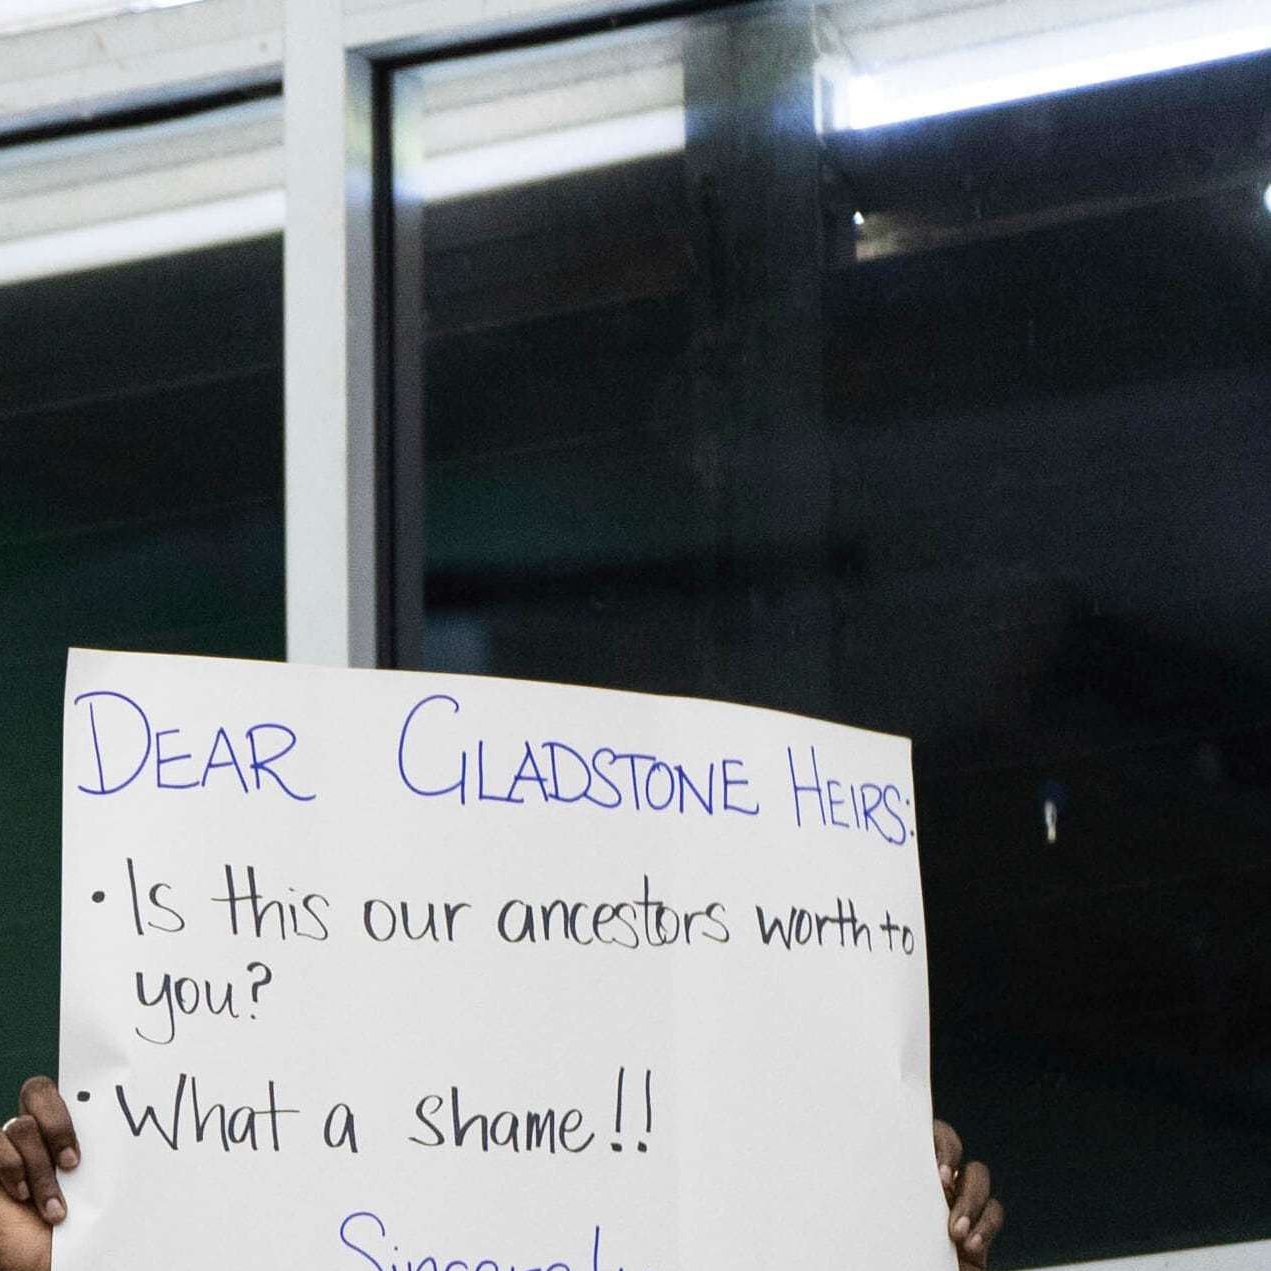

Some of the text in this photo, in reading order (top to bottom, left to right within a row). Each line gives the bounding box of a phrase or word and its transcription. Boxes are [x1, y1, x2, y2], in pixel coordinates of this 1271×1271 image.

[74, 690, 917, 847] DEAR GLADSTONE HEIRS:
[125, 857, 914, 955] Is this our ancestors worth to
[135, 961, 272, 1045] you?
[115, 1073, 300, 1152] What
[324, 1103, 358, 1153] a
